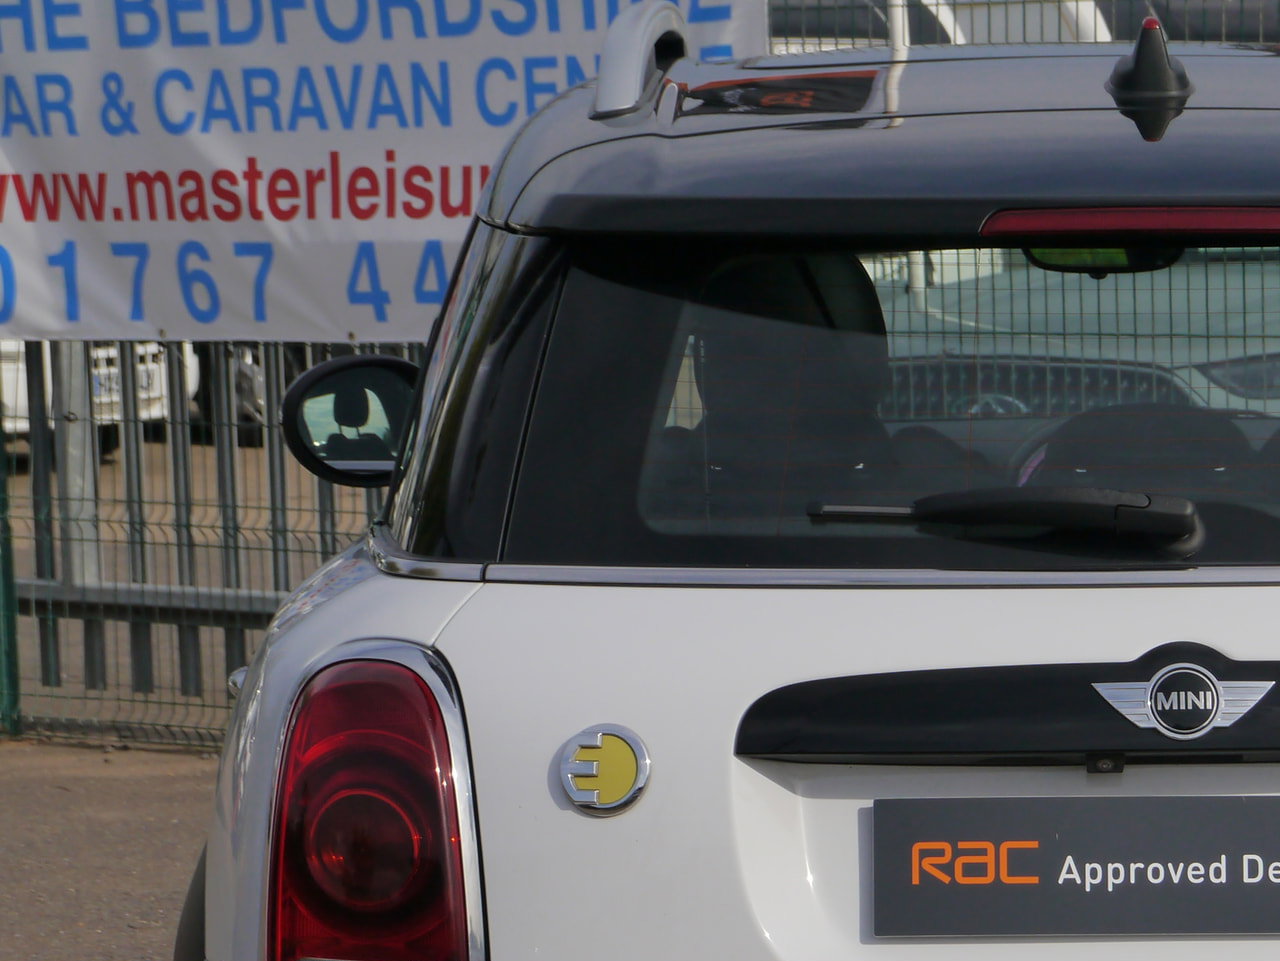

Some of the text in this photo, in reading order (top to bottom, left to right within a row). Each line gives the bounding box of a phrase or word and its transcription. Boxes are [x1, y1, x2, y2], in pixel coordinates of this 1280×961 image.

[101, 71, 140, 136] &
[155, 61, 453, 135] CARAVAN
[0, 150, 491, 221] ww.masterleisu
[1156, 691, 1213, 711] MINI
[1057, 854, 1227, 892] Approved
